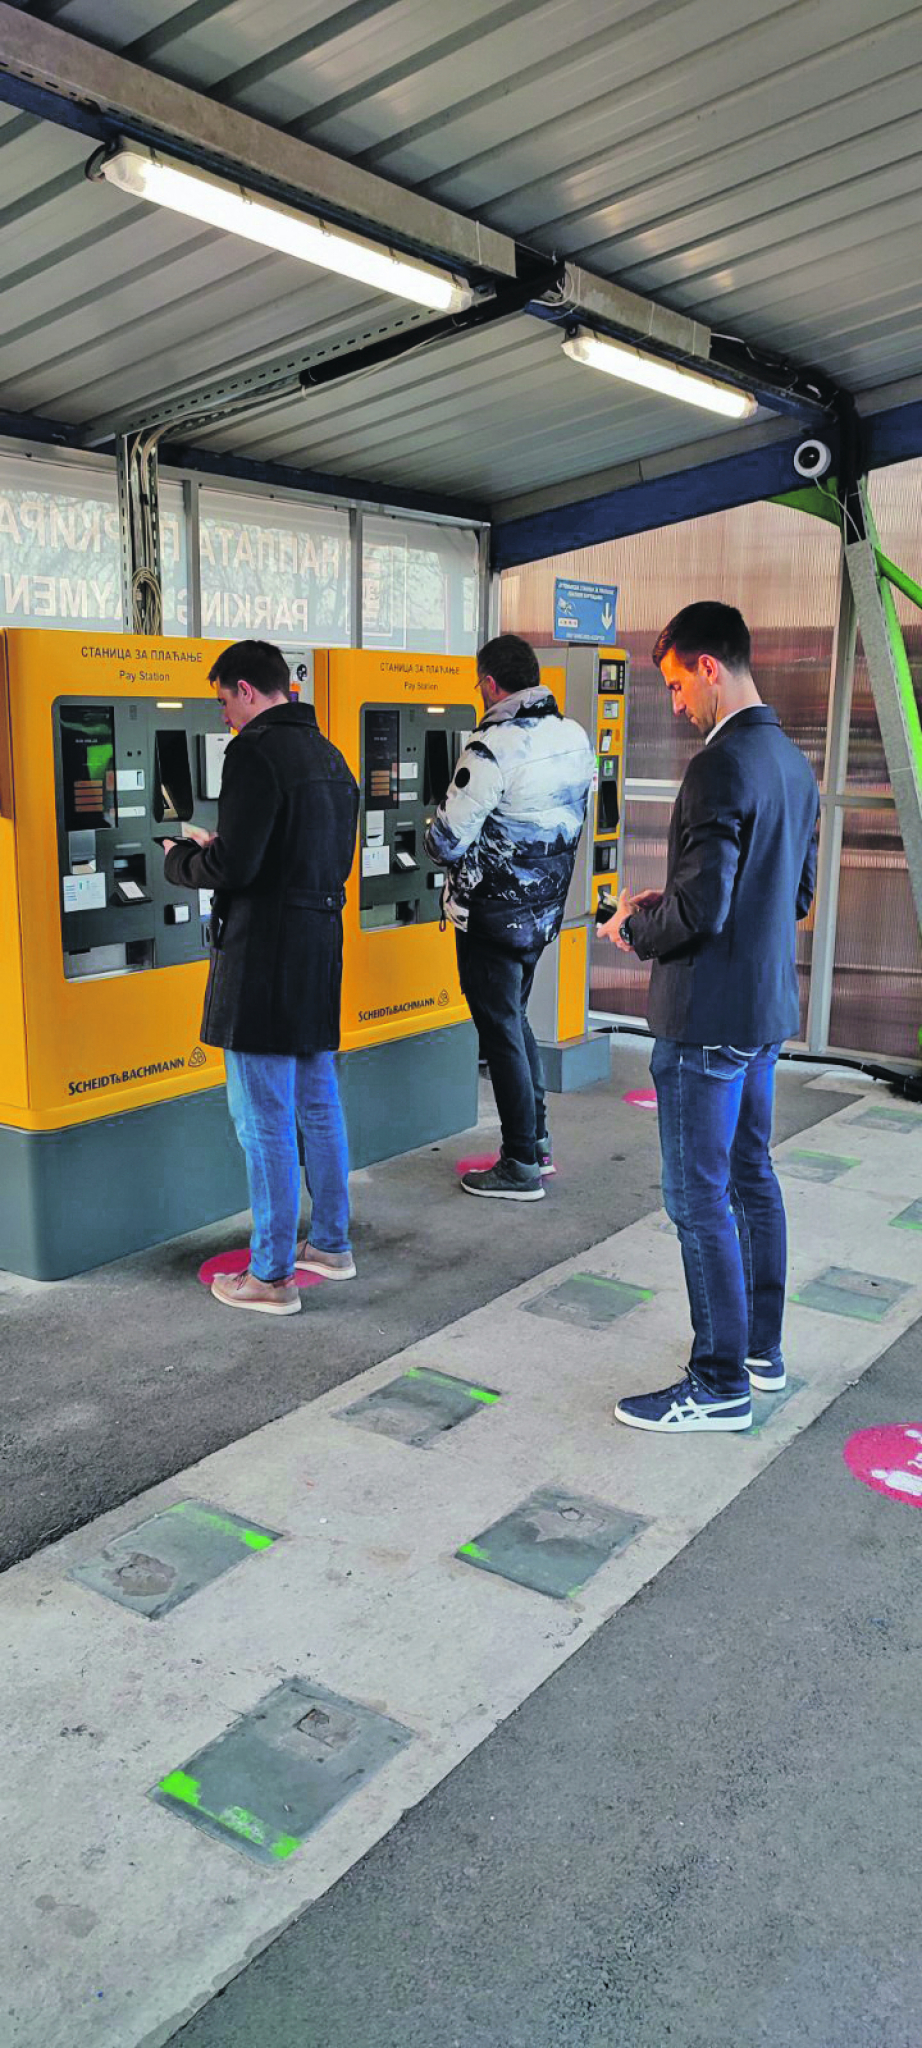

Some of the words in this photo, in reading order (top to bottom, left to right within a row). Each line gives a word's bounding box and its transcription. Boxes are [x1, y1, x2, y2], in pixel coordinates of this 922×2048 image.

[81, 646, 131, 660] СТАНИЦА
[135, 649, 147, 659] ЗА
[151, 650, 203, 662] ПЛАЋАЊЕ
[380, 662, 413, 673] СТАНИЦА
[415, 663, 424, 672] ЗА
[119, 670, 136, 682] Pay
[139, 671, 170, 681] Station
[404, 681, 416, 691] Pay
[417, 682, 439, 690] Station
